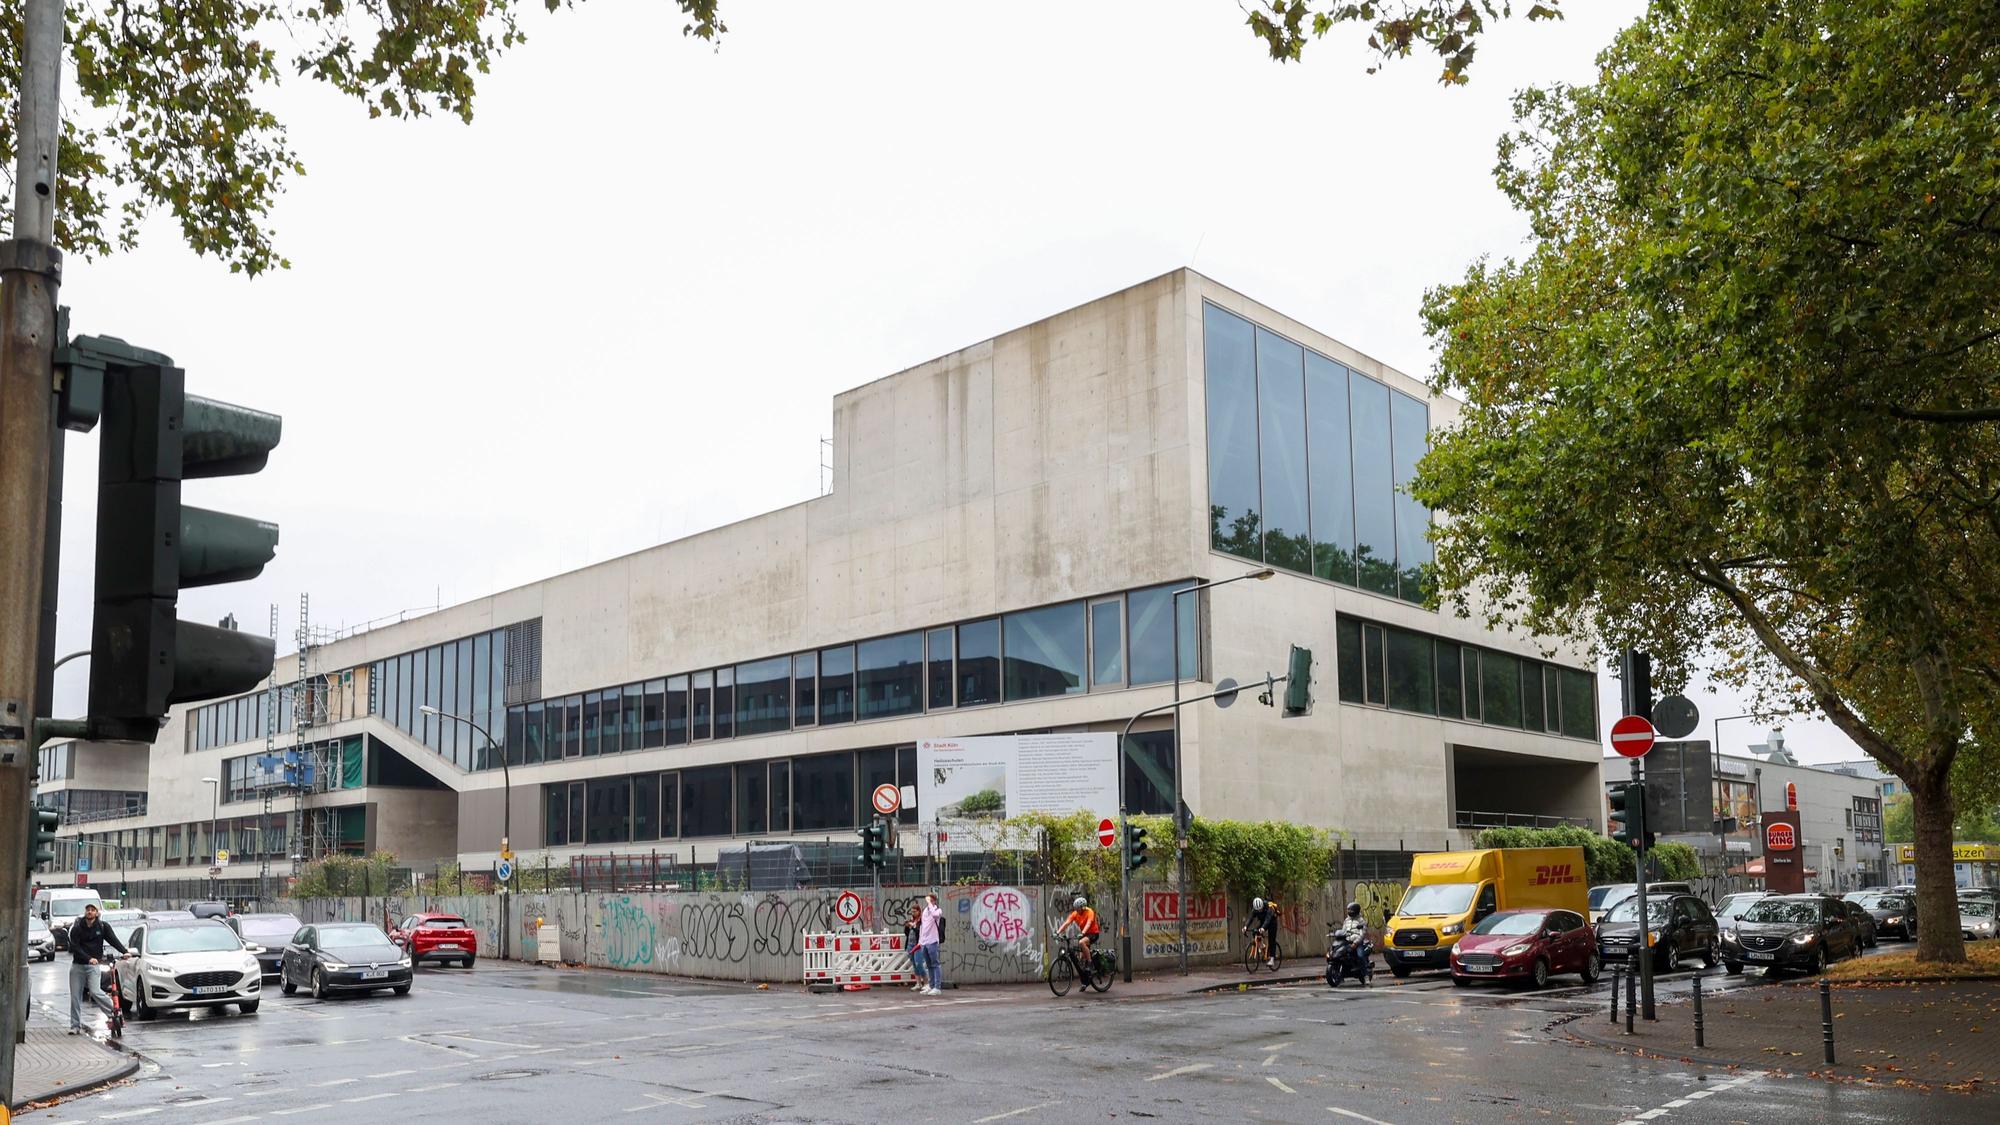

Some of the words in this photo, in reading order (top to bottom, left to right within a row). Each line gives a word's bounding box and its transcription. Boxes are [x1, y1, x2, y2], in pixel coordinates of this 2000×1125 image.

[1768, 837, 1793, 845] KING
[1953, 849, 1985, 858] atzen
[1429, 862, 1459, 870] DHL
[1535, 864, 1574, 885] DHL
[982, 892, 1021, 911] CAR
[996, 911, 1010, 922] IS
[979, 918, 1029, 940] OVER
